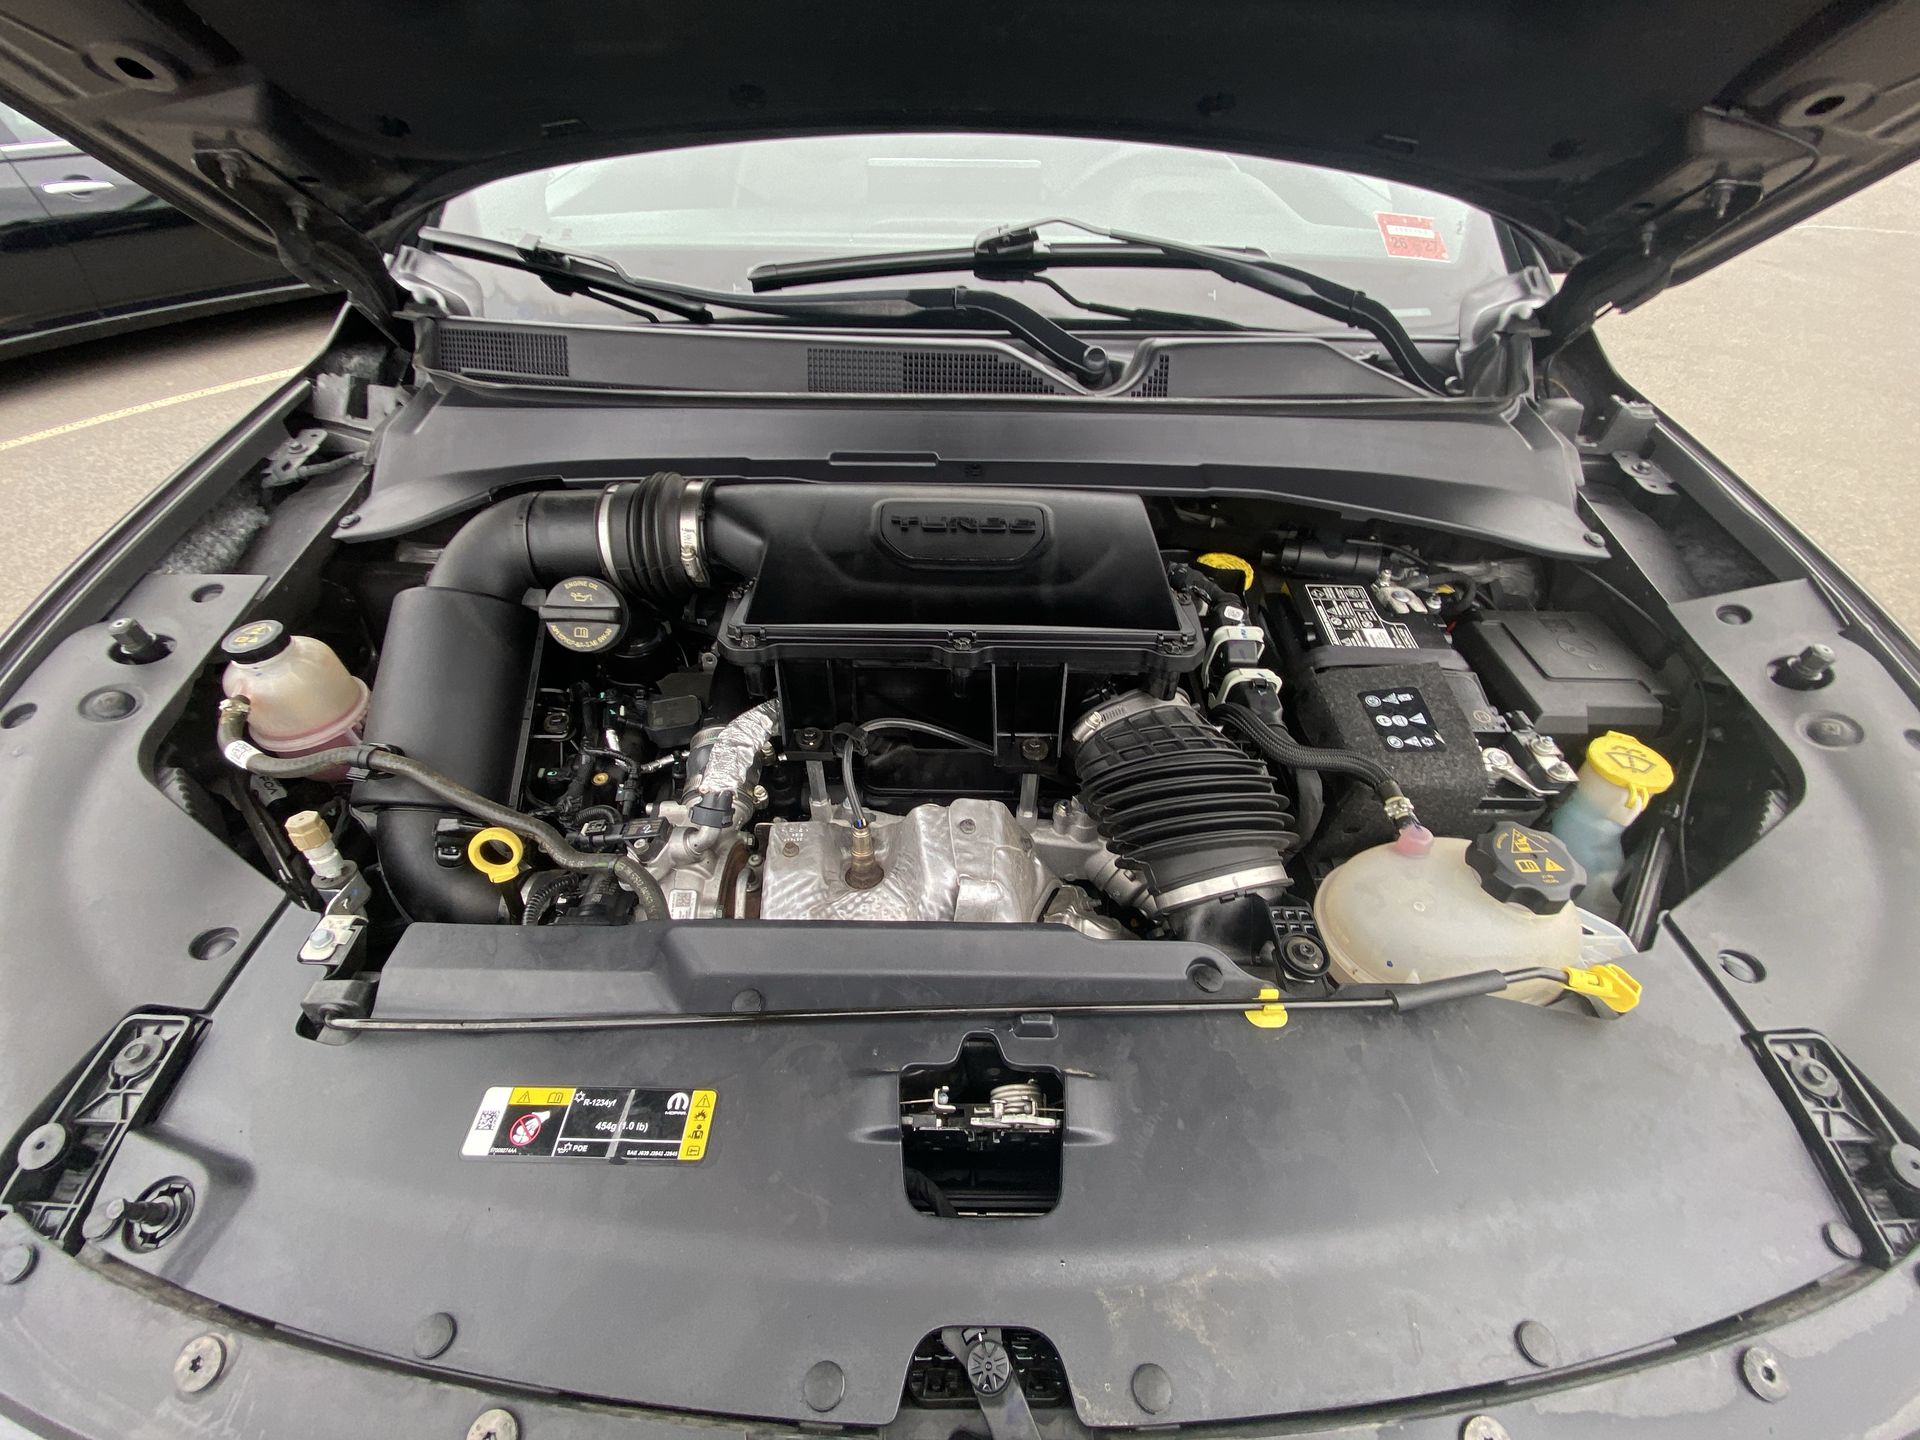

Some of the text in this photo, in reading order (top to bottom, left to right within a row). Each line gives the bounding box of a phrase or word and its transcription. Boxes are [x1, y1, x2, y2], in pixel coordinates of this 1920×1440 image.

[1390, 236, 1408, 249] 26
[564, 580, 598, 591] ENGINE OIL
[583, 1098, 617, 1108] R-1234yf
[595, 1121, 617, 1133] 454g
[636, 1122, 649, 1133] lb)
[572, 1144, 589, 1152] POE
